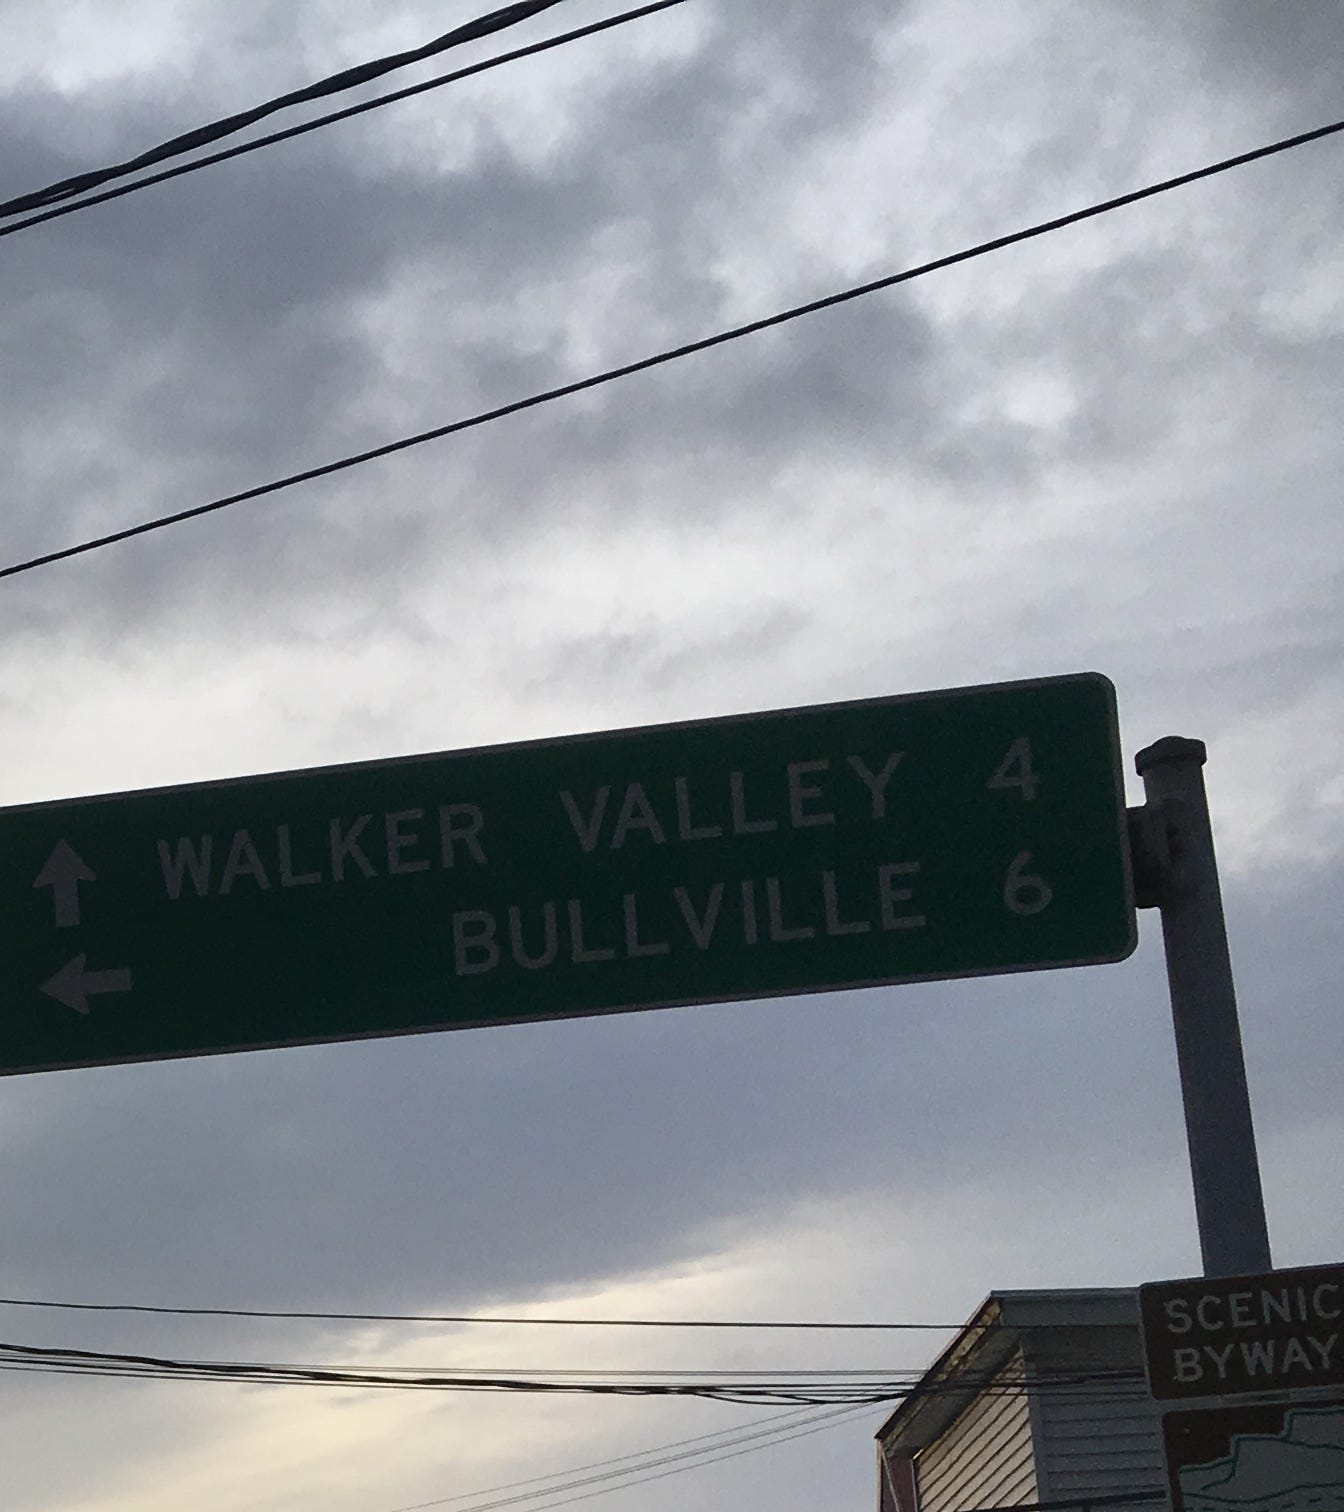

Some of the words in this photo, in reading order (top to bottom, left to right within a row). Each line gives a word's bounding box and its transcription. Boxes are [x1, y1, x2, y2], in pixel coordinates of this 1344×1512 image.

[157, 802, 489, 900] WALKER
[560, 750, 904, 853] VALLEY
[986, 737, 1040, 805] 4
[451, 861, 928, 977] BULLVILLE
[1002, 849, 1054, 918] 6
[1163, 1283, 1341, 1334] SCENIC
[1172, 1333, 1339, 1383] BYWAY
